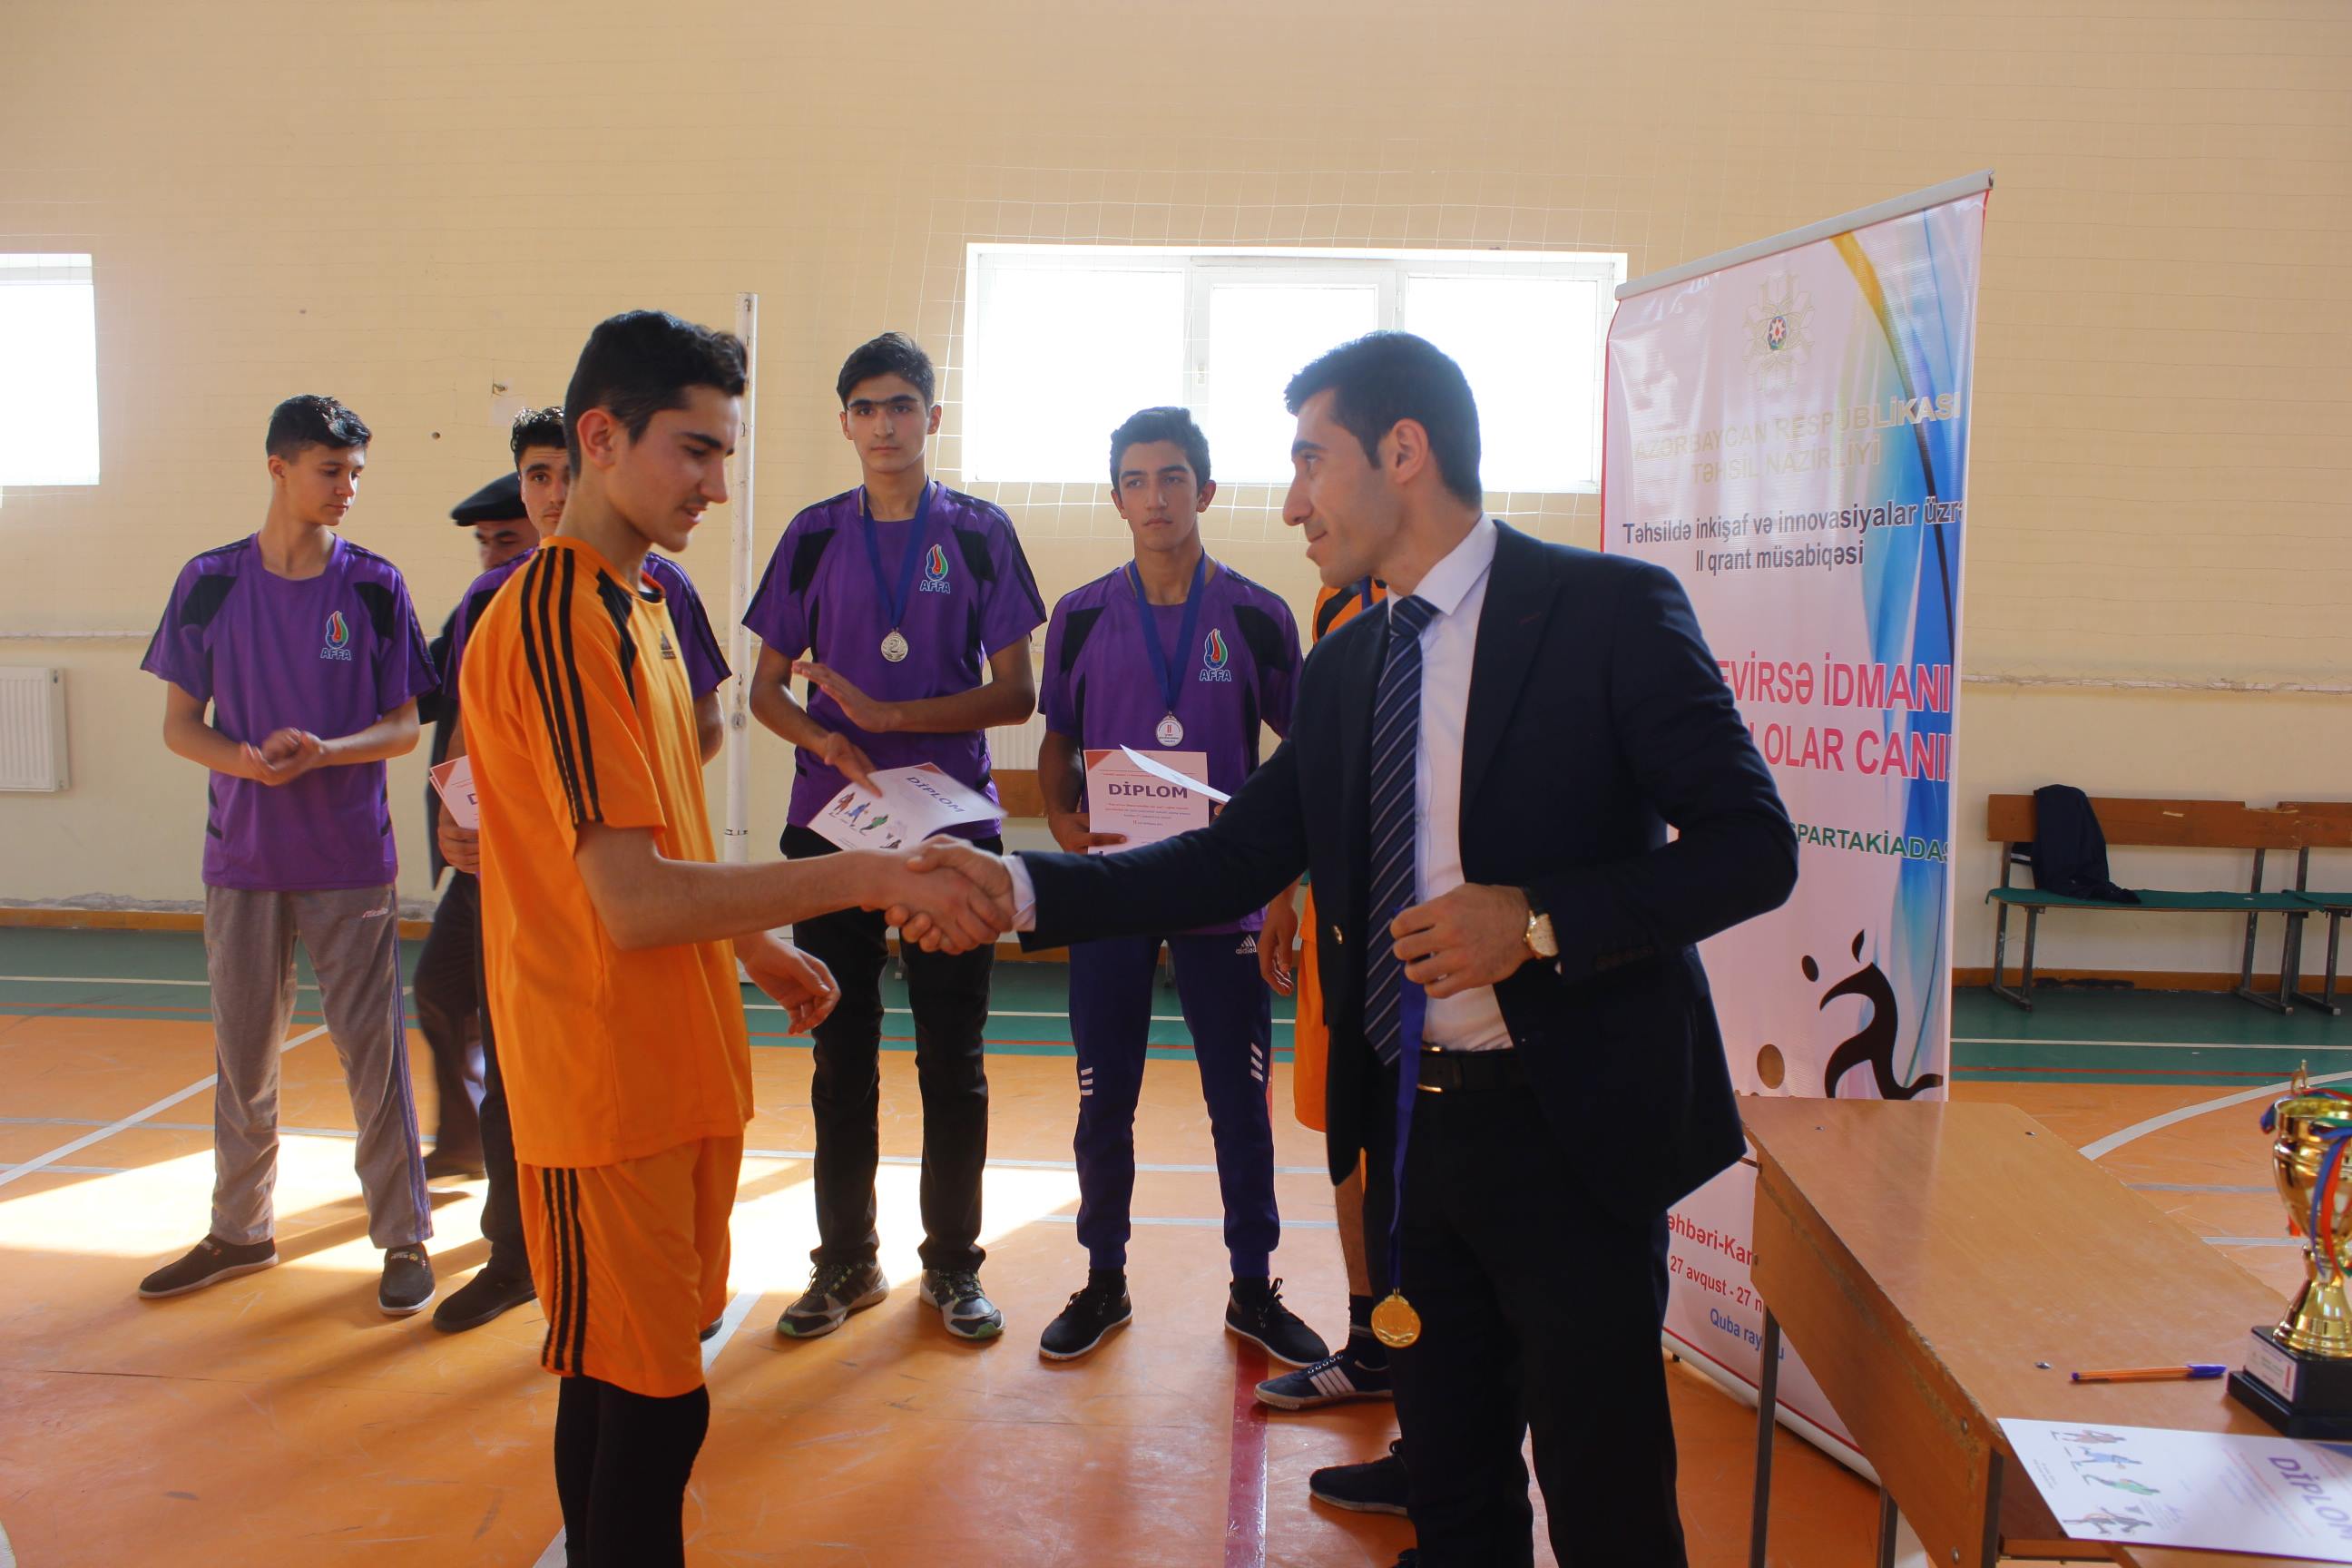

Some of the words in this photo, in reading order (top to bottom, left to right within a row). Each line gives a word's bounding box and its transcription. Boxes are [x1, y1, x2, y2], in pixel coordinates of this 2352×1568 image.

[1691, 454, 1759, 485] TƏHSİL
[1766, 434, 1880, 475] NAZİRLİYİ
[1622, 522, 1691, 544] Təhsildə
[1696, 513, 1749, 543] inkişaf
[1752, 517, 1772, 534] və
[1779, 501, 1916, 533] innovasiyalar
[1708, 548, 1751, 575] qrant
[1757, 541, 1864, 571] müsabiqəsi
[920, 579, 951, 593] AFFA
[320, 648, 352, 661] AFFA
[1200, 669, 1232, 681] AFFA
[1764, 722, 1845, 771] OLAR
[1856, 730, 1950, 782] CANI
[906, 777, 965, 812] DİPLOM
[1108, 780, 1189, 799] DİPLOM
[1235, 946, 1257, 955] adida
[1670, 1255, 1683, 1274] 27
[1686, 1266, 1727, 1297] avqust
[1737, 1286, 1751, 1307] 27
[1710, 1308, 1740, 1338] Quba
